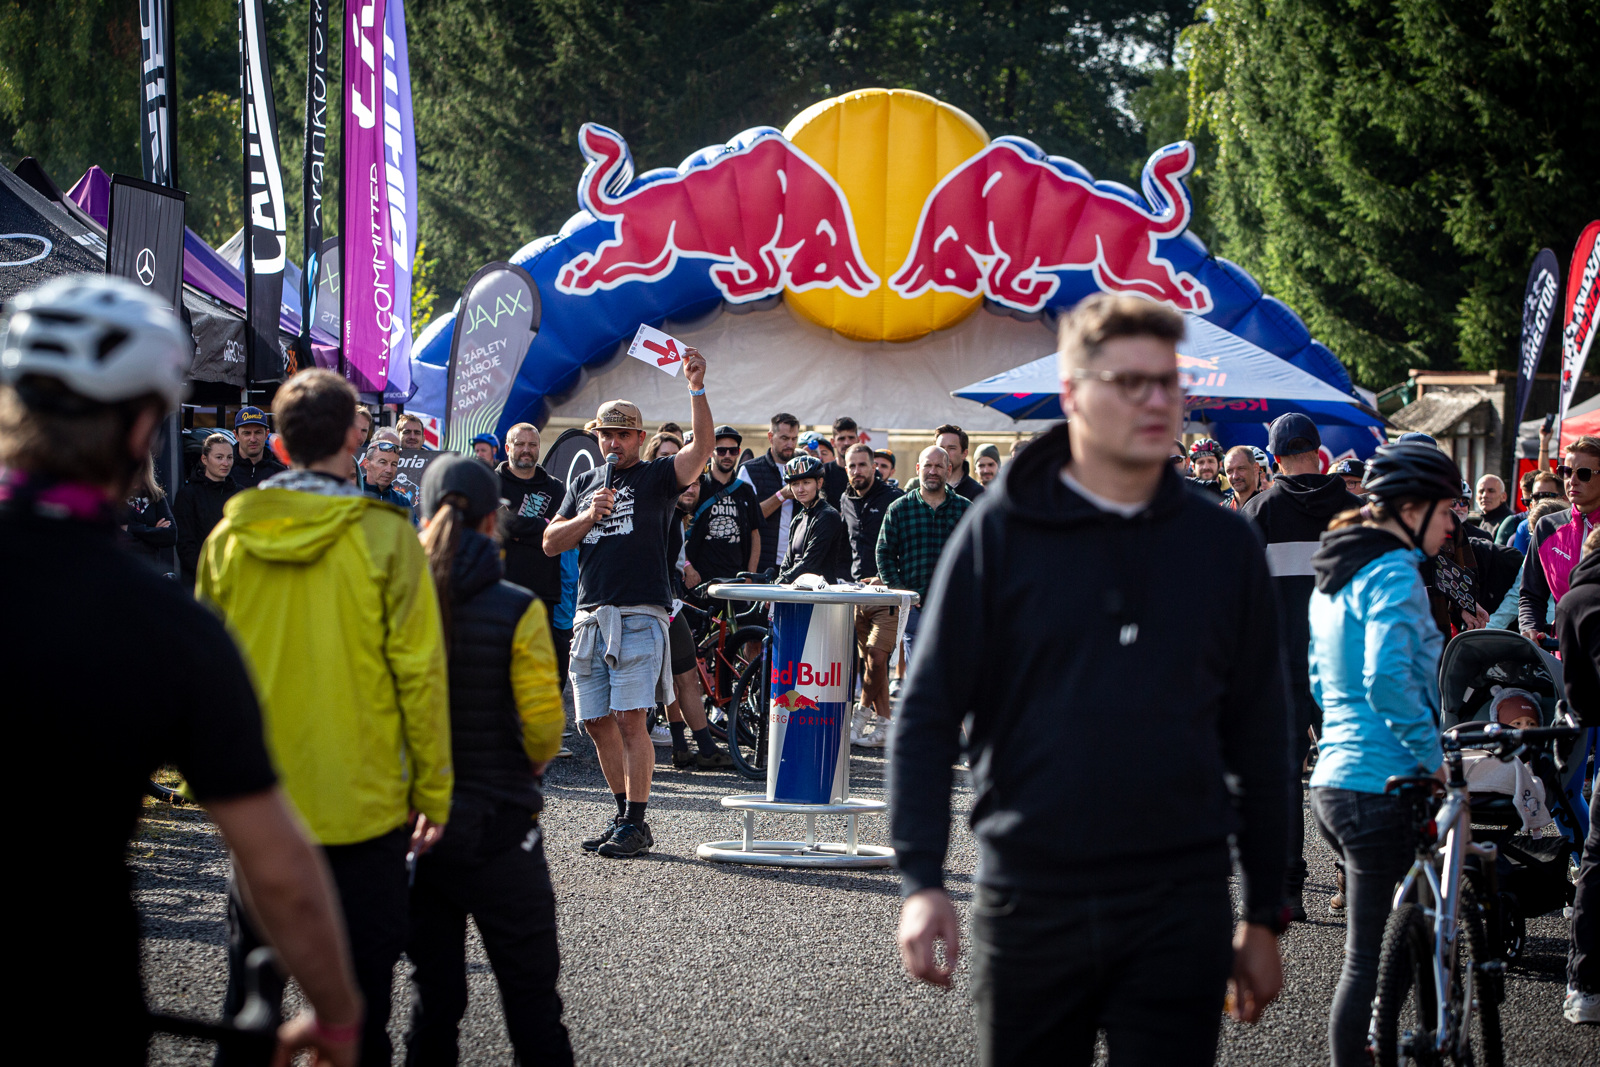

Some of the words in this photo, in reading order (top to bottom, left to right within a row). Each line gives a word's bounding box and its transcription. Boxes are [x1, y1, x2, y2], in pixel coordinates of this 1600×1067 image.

[466, 289, 527, 334] JAAX
[463, 338, 507, 365] ZÁPLETY
[461, 355, 501, 379] NÁBOJE
[460, 373, 492, 395] RÁFKY
[458, 389, 488, 410] RÁMY
[797, 662, 841, 687] Bull
[799, 716, 836, 726] DRINK
